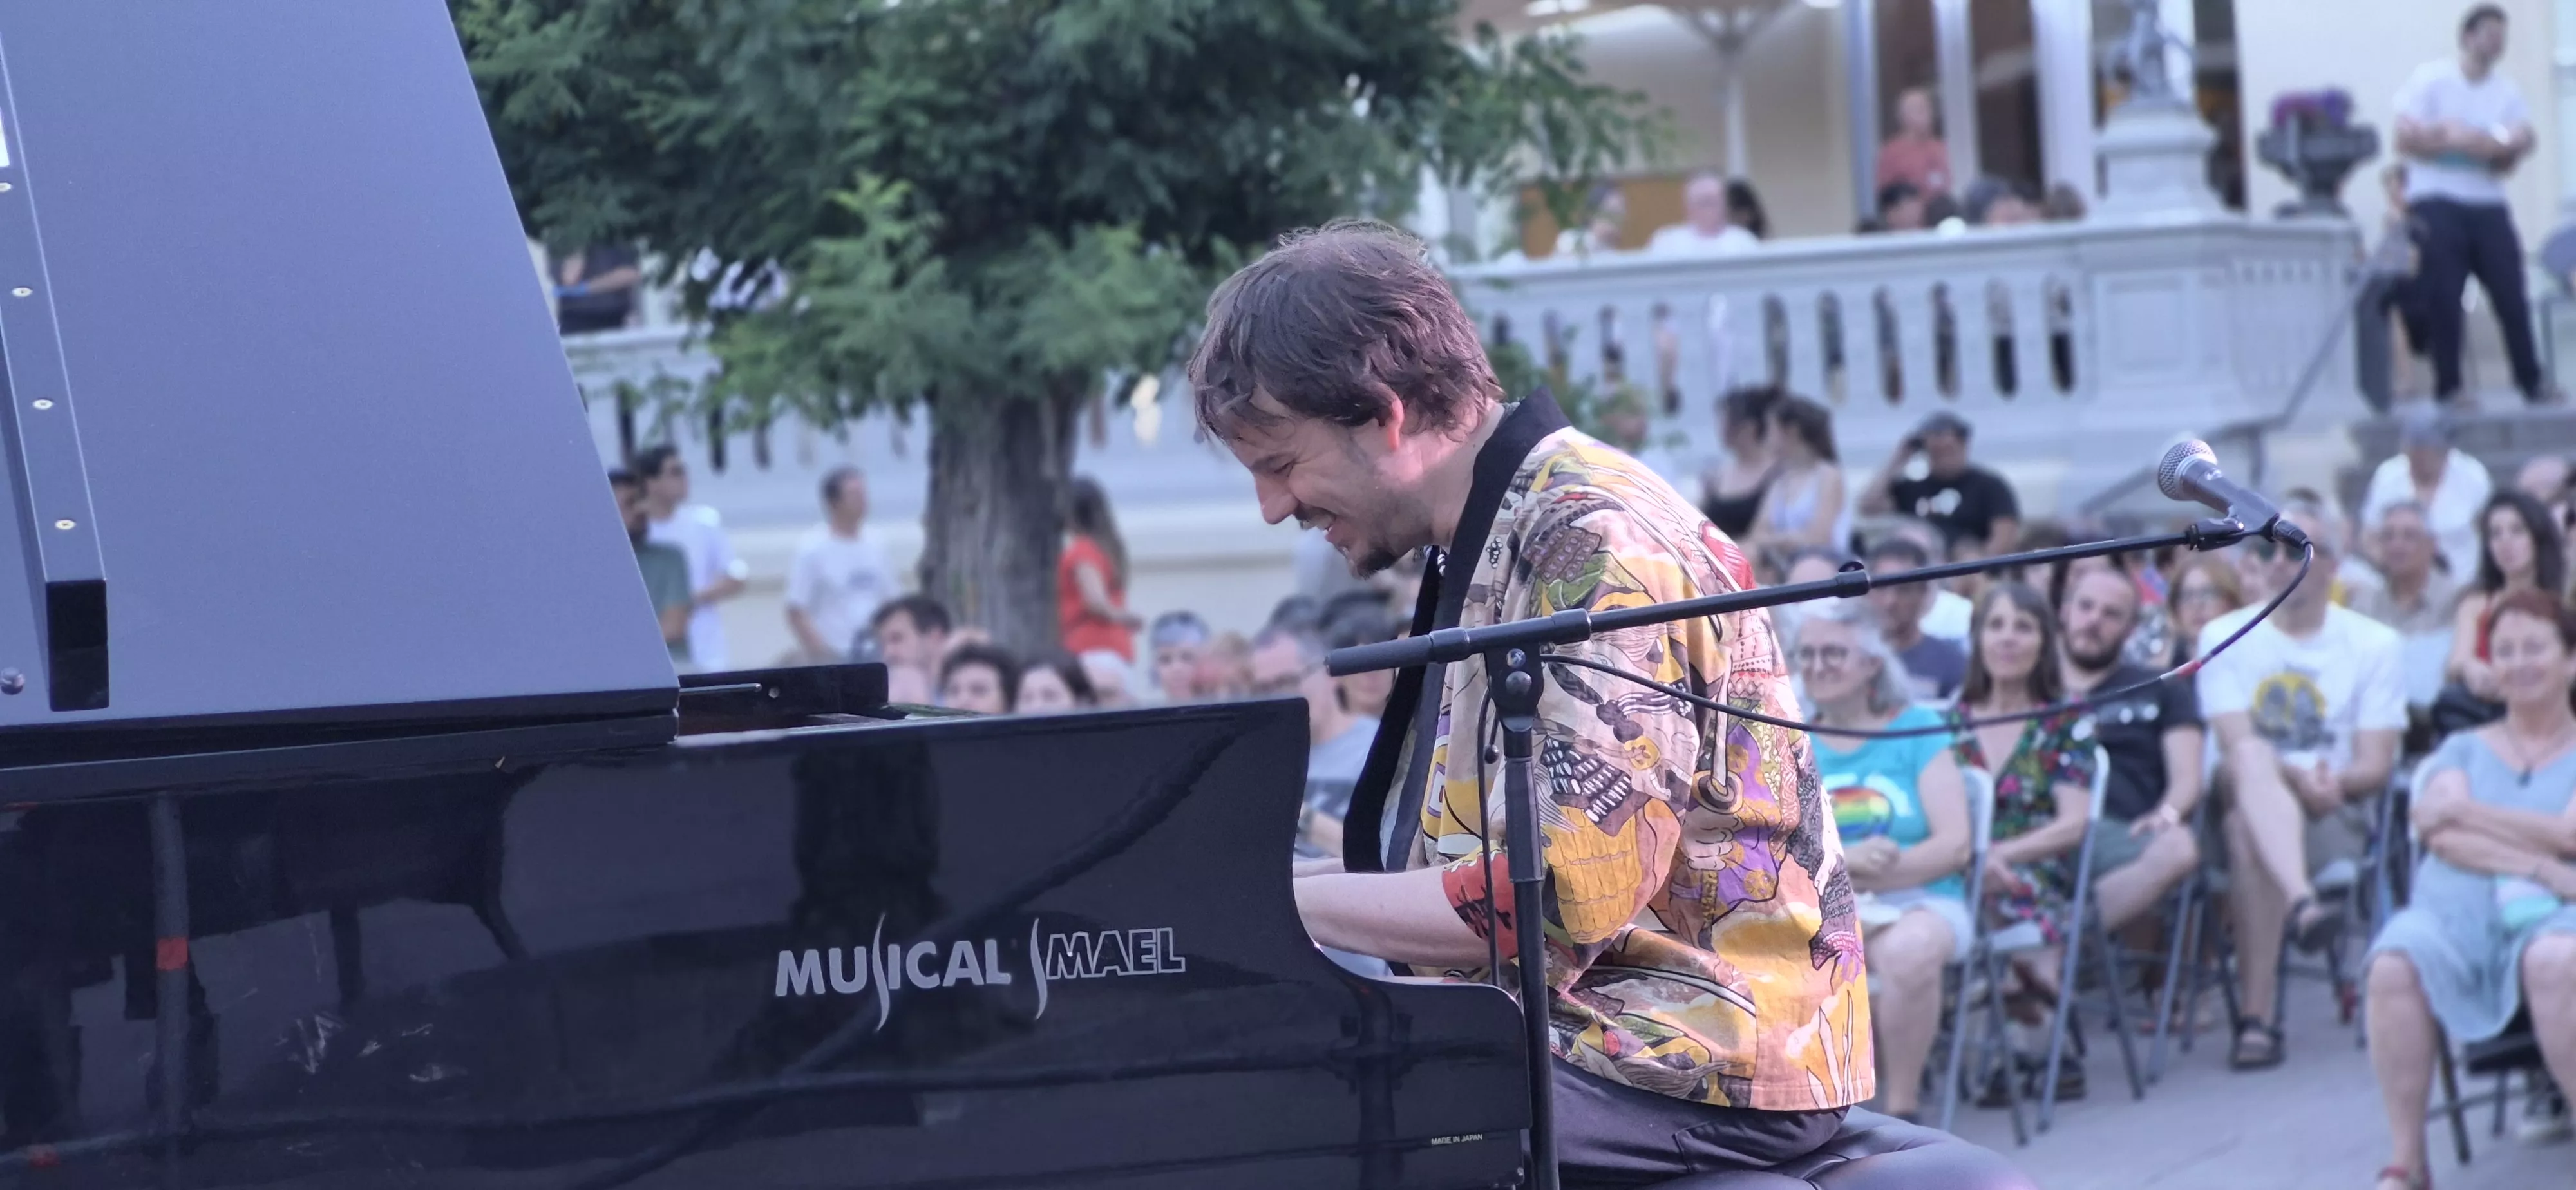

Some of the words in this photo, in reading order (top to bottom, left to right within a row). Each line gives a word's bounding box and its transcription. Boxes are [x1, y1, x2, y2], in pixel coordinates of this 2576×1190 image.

[775, 912, 1012, 1031] MUSICAL
[1431, 1137, 1452, 1145] MADE
[1461, 1134, 1482, 1142] JAPAN
